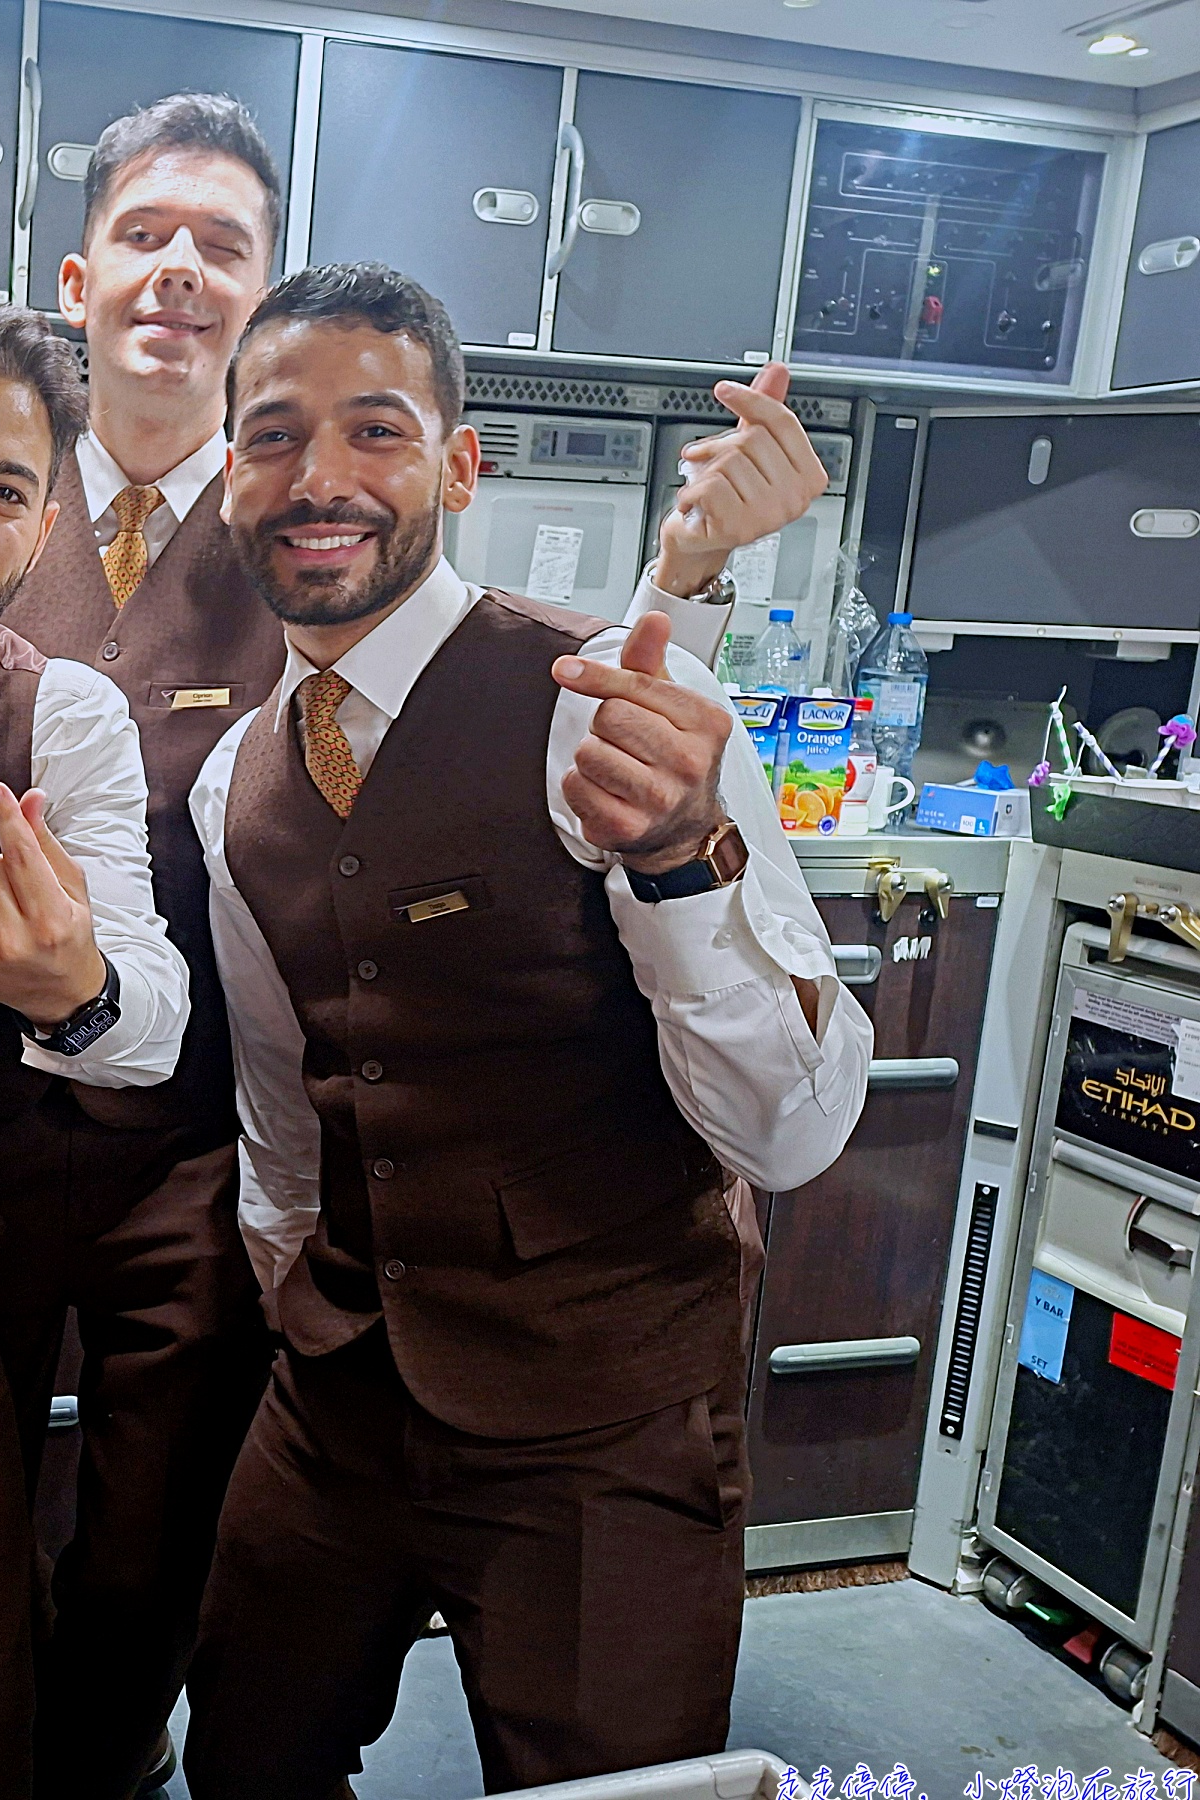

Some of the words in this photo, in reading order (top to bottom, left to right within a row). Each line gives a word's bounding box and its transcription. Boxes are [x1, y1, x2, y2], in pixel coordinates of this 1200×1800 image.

[802, 709, 845, 720] LACNOR
[797, 732, 843, 746] Orange
[1082, 1079, 1196, 1131] ETIHAD
[1101, 1104, 1169, 1135] AIRWAYS
[1034, 1296, 1042, 1306] Y
[1043, 1300, 1064, 1319] BAR
[1031, 1355, 1049, 1370] SET
